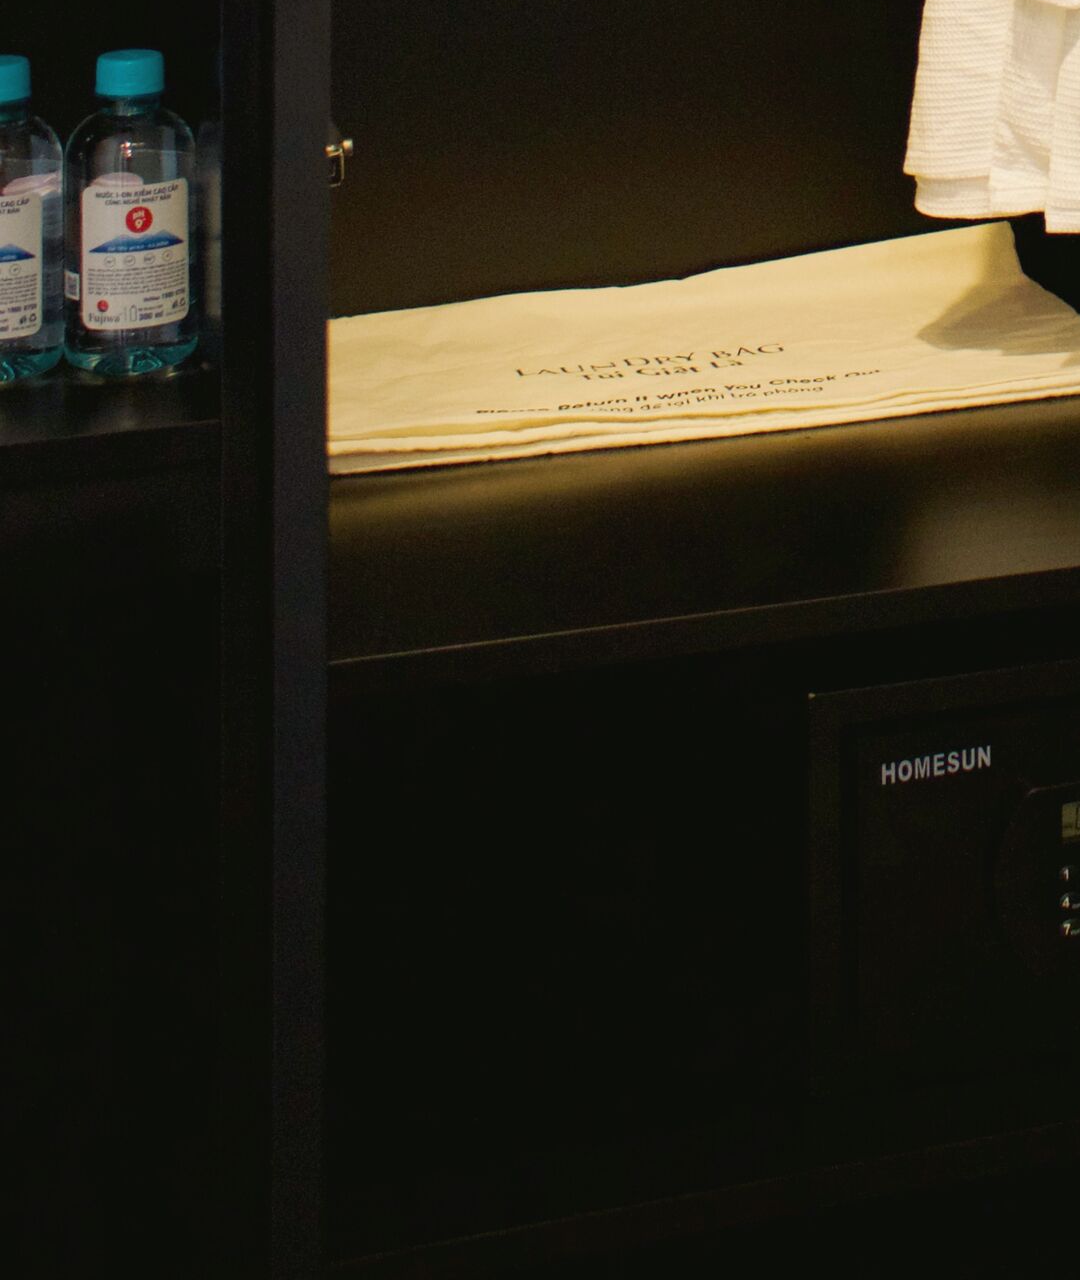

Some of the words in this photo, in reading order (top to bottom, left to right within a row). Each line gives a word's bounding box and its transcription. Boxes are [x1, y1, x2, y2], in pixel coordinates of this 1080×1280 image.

[516, 352, 694, 376] LAUNDRY
[712, 343, 785, 358] BAG
[725, 383, 761, 392] You
[881, 745, 991, 786] HOMESUN
[1063, 868, 1069, 881] 1
[1062, 896, 1070, 908] 4
[1063, 923, 1071, 935] 7
